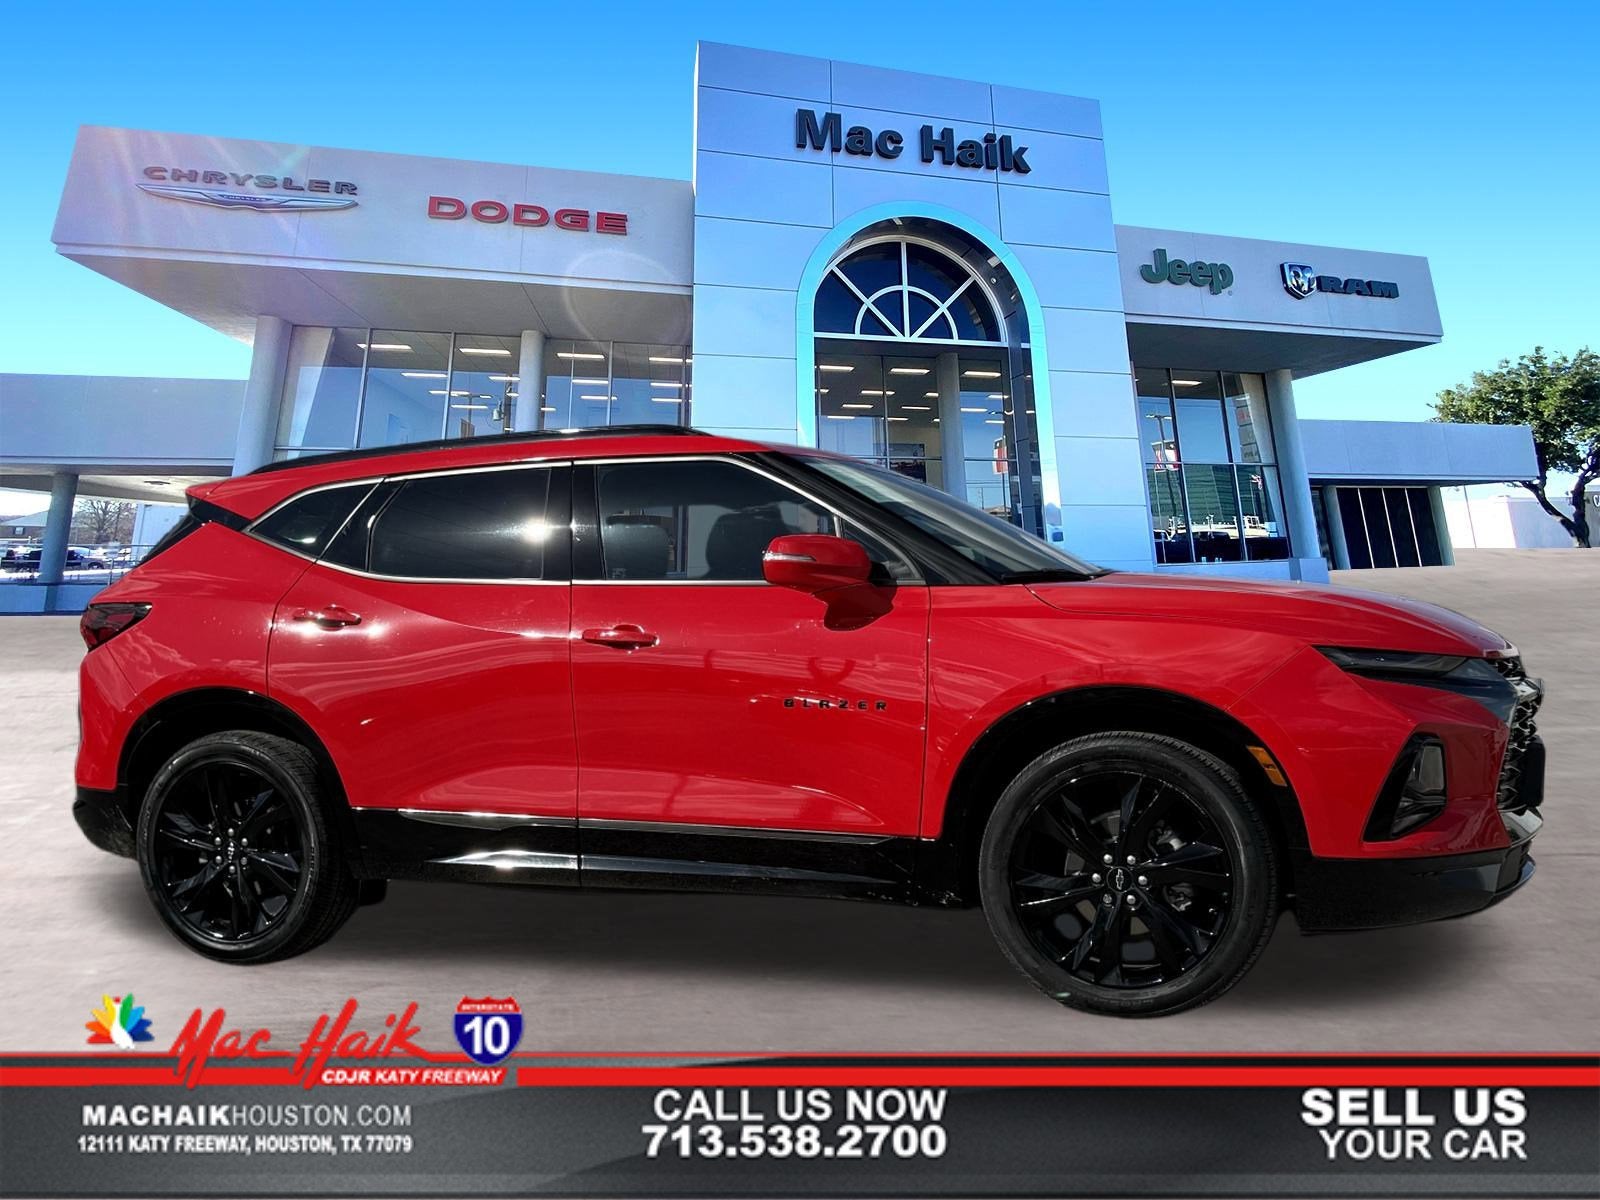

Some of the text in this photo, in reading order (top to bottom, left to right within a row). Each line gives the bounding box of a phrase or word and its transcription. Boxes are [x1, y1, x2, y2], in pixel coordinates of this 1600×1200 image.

[796, 108, 1032, 174] Mac Haik
[143, 165, 358, 196] CHRYSLER
[428, 196, 628, 236] DODGE
[1139, 248, 1234, 295] Jeep
[1315, 275, 1400, 299] RAM
[784, 698, 887, 711] BLAZER
